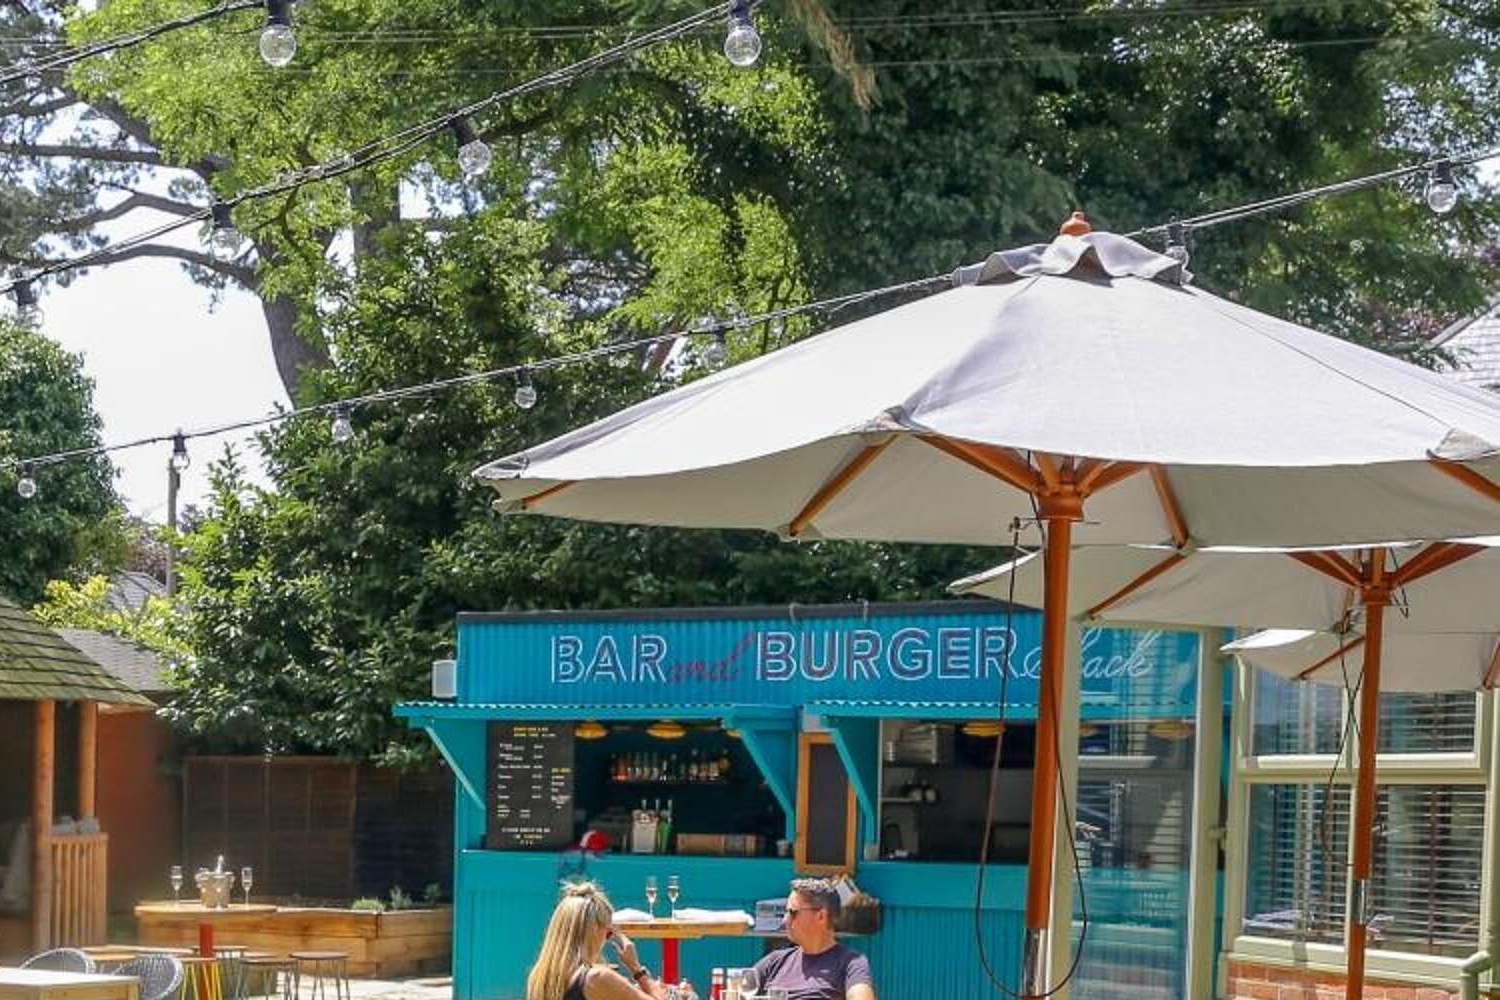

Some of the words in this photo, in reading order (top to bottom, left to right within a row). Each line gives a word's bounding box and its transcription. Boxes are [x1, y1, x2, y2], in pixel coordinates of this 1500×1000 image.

[550, 633, 667, 683] BAR
[668, 631, 756, 682] and
[756, 627, 1018, 680] BURGER
